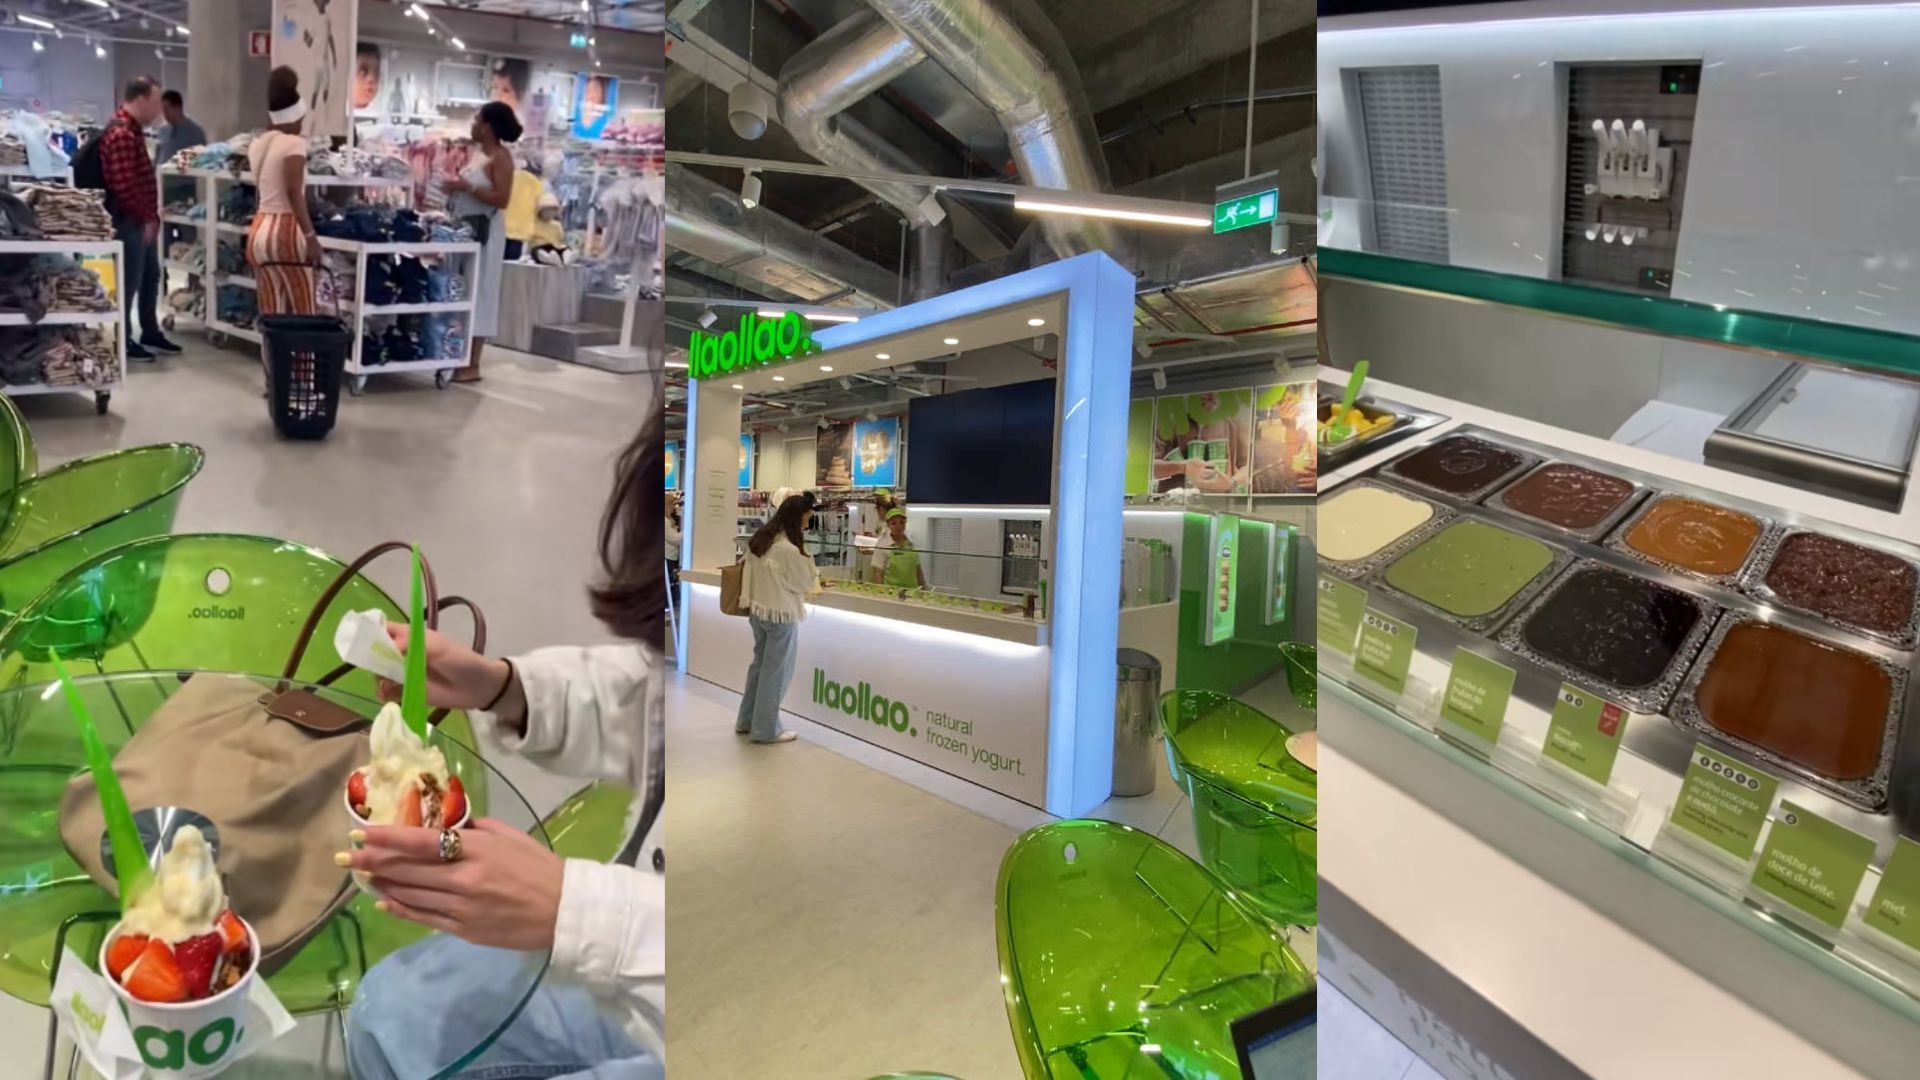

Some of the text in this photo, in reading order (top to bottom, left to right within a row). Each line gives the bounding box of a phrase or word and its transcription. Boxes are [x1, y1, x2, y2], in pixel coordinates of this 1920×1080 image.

[688, 310, 811, 378] llaollao.
[812, 667, 918, 738] llaollao.
[926, 709, 973, 736] natural
[926, 727, 1025, 776] frozen yogurt.
[1767, 859, 1793, 879] doce
[1794, 872, 1809, 886] de
[1771, 848, 1823, 879] molho de
